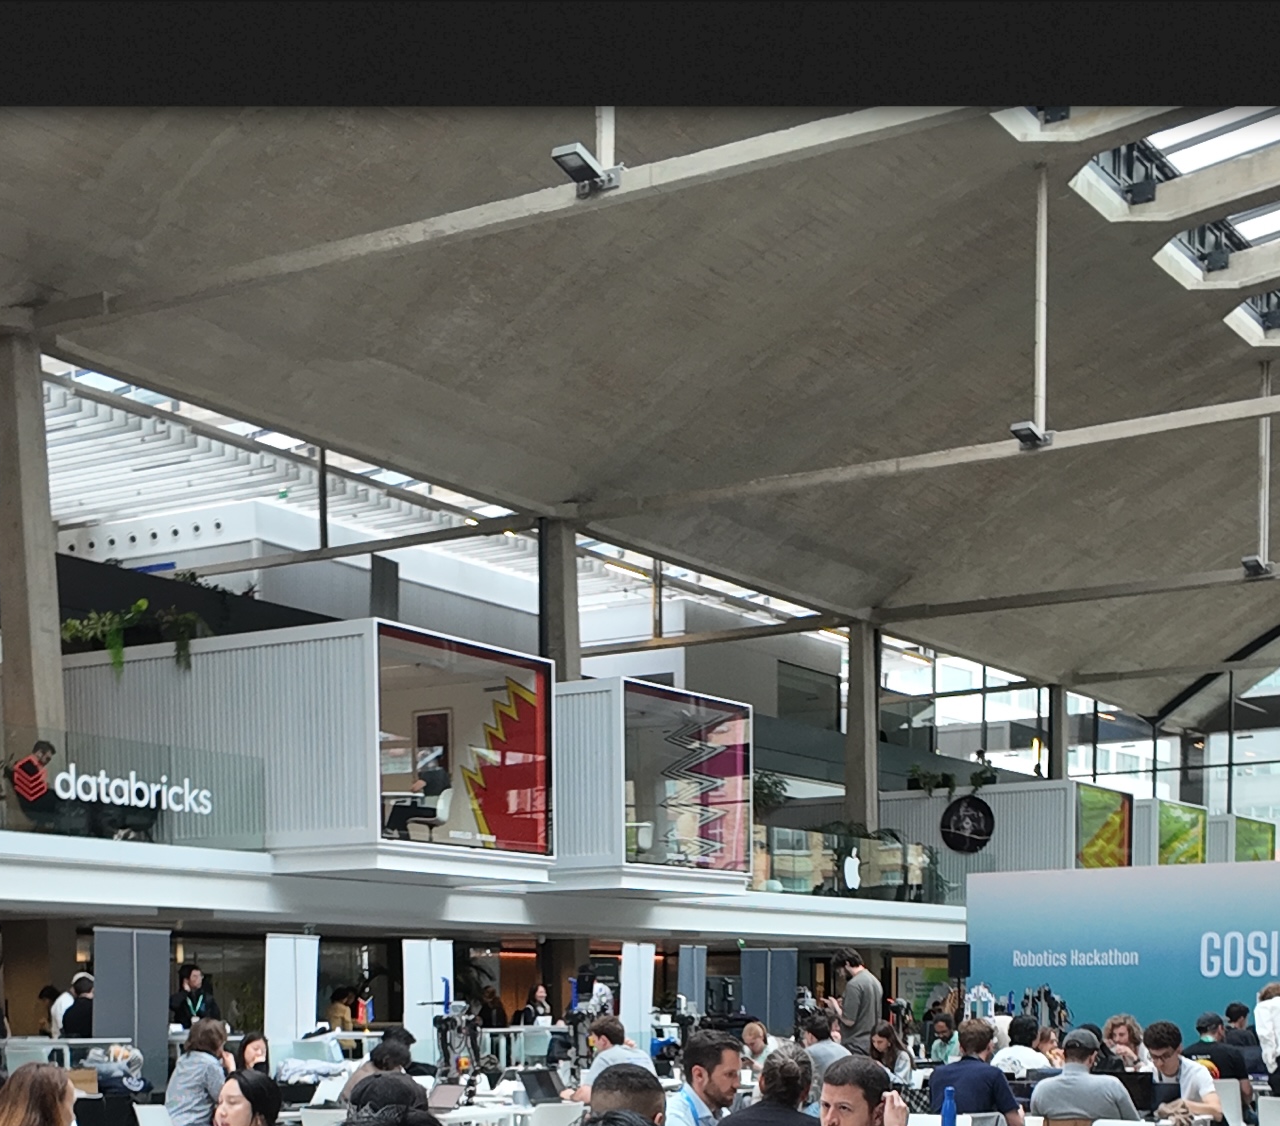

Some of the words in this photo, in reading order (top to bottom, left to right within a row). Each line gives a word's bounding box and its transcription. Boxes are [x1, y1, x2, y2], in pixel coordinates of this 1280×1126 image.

[54, 763, 213, 815] databricks
[1012, 949, 1067, 967] Robotics
[1070, 948, 1139, 966] Hackathon
